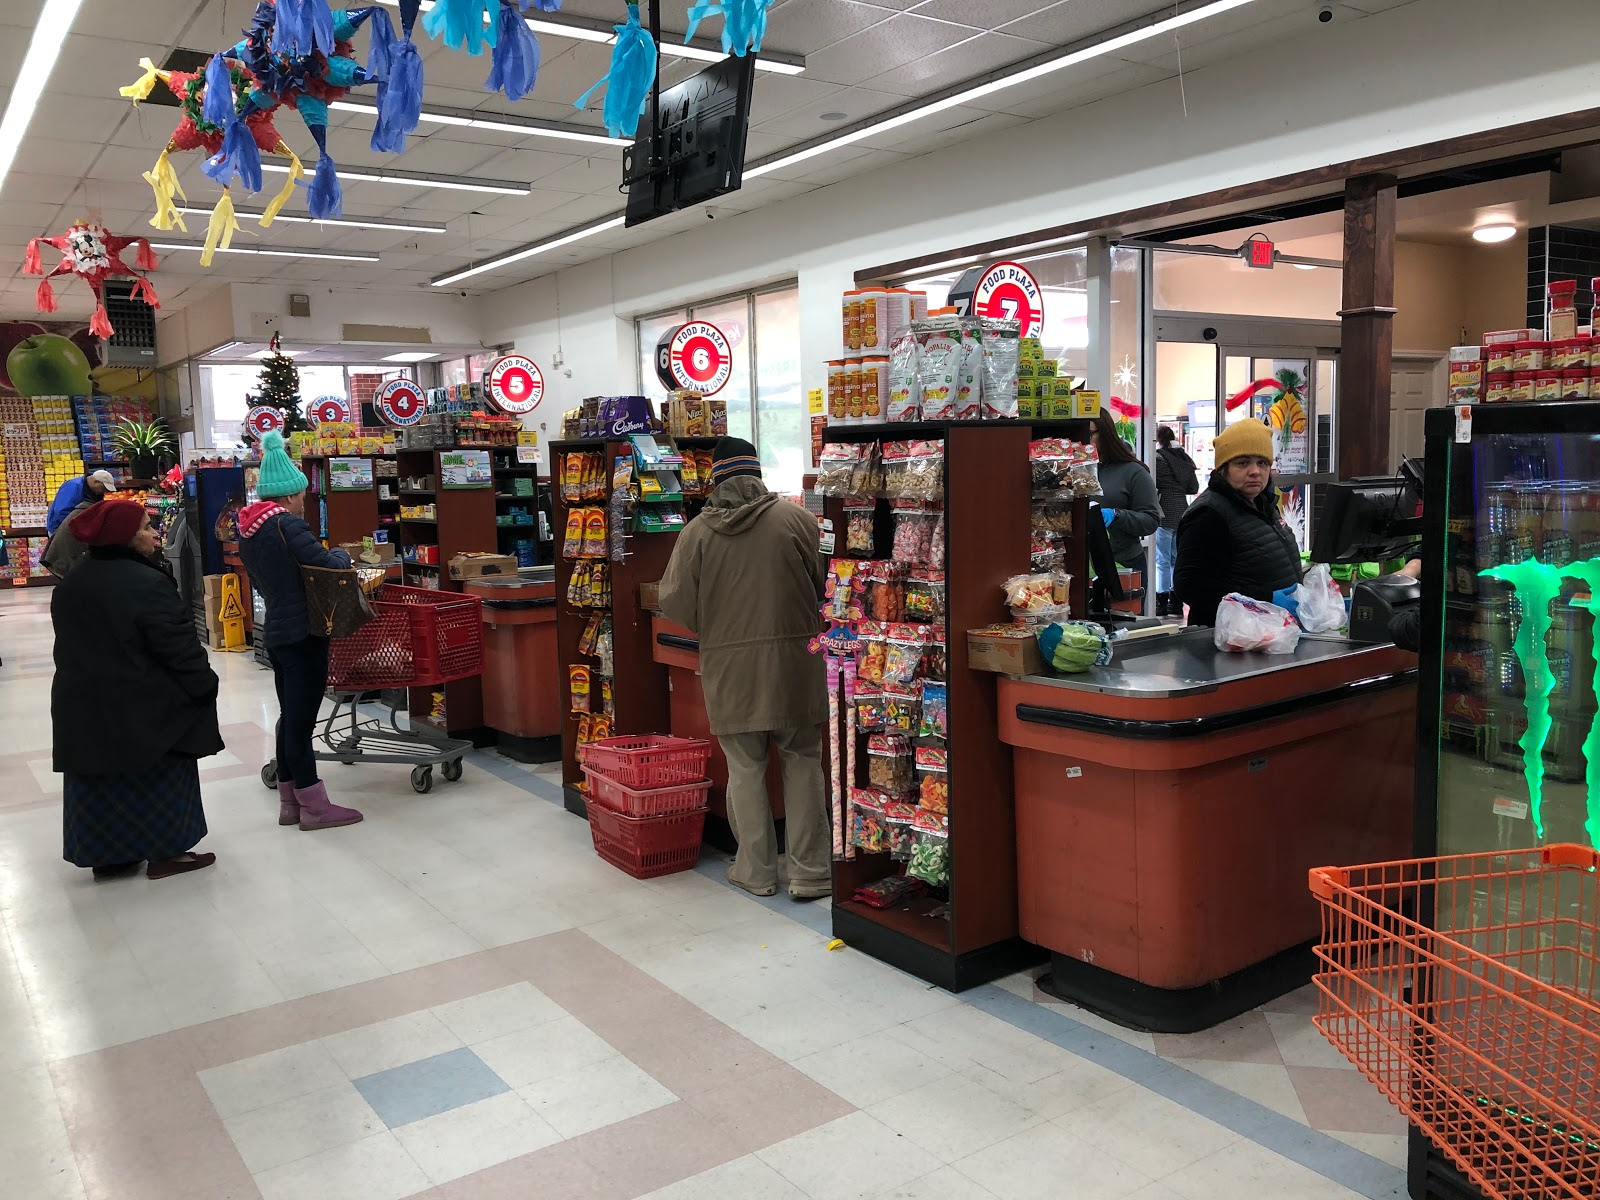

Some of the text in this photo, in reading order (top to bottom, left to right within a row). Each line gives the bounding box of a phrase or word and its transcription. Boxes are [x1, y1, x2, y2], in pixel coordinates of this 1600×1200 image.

[1253, 241, 1273, 265] EXIT
[982, 268, 1036, 299] FOOD PLAZA
[953, 298, 970, 317] 7
[1000, 297, 1019, 321] 7
[677, 326, 725, 349] FOOD PLAZA
[925, 343, 954, 355] NOPALINA
[660, 347, 669, 369] 6
[692, 347, 710, 372] 6
[495, 359, 537, 376] FOOD PLAZA
[509, 375, 524, 395] 5
[673, 362, 729, 393] INTERNATIONAL
[387, 381, 421, 397] FOOD PLAZA
[315, 395, 346, 408] FOOD PLAZA
[397, 395, 410, 410] 4
[493, 388, 541, 411] INTERNATIONAL
[252, 407, 281, 419] FOOD PLAZA
[325, 407, 336, 420] 3
[384, 405, 424, 425] INTERNATIONAL
[686, 409, 703, 420] Nips
[710, 408, 728, 421] Nips
[262, 418, 271, 429] 2
[612, 419, 645, 436] Cadbury
[820, 635, 861, 650] CRAZY LEGS
